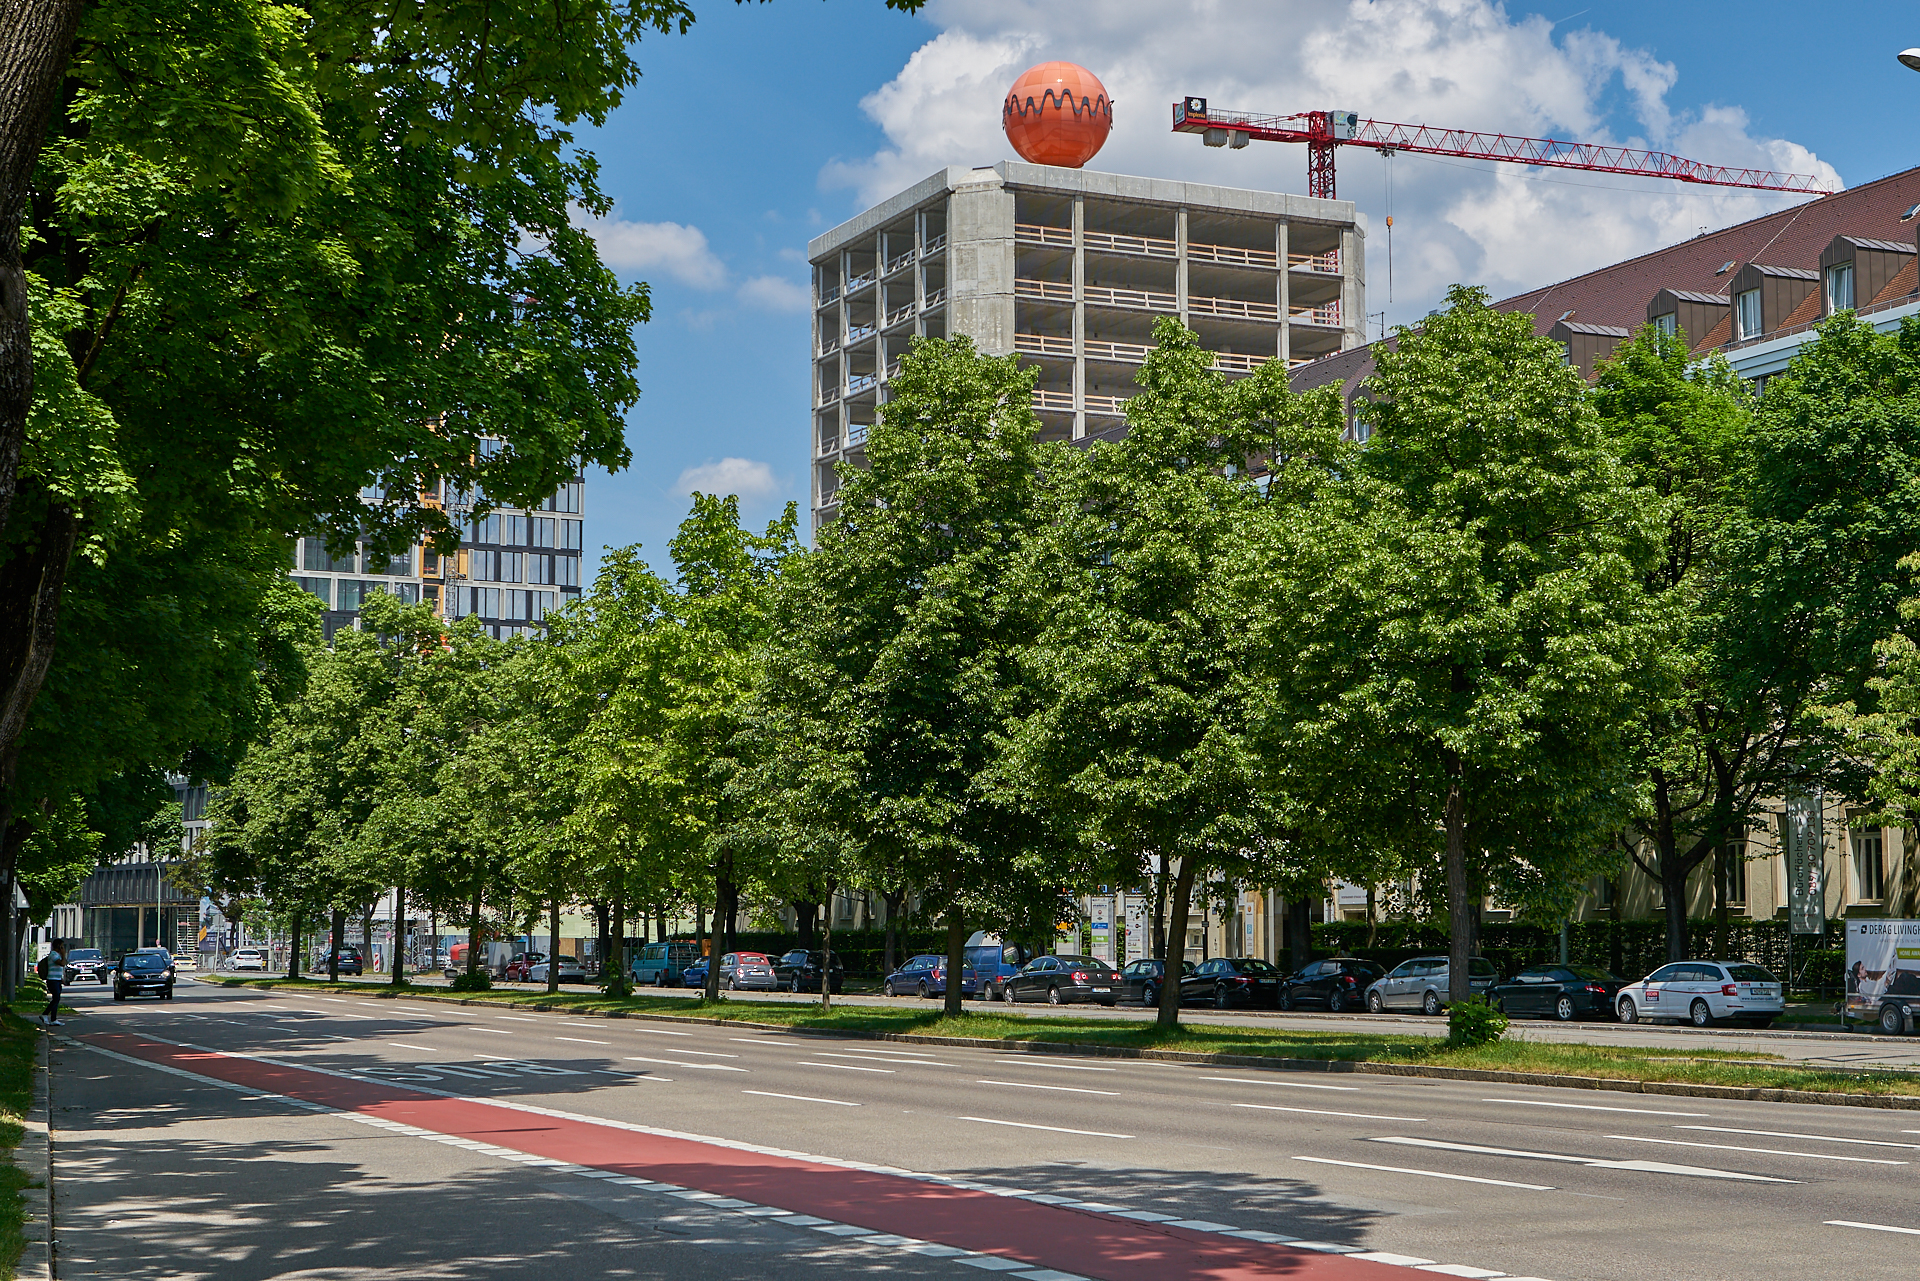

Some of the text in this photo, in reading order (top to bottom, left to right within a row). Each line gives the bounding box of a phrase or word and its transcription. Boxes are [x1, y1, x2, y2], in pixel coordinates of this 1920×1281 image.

[1806, 810, 1816, 829] 133
[1807, 831, 1816, 852] 709
[1794, 833, 1804, 896] Büroflächen
[1807, 854, 1817, 868] 30
[1869, 925, 1892, 934] DERAG
